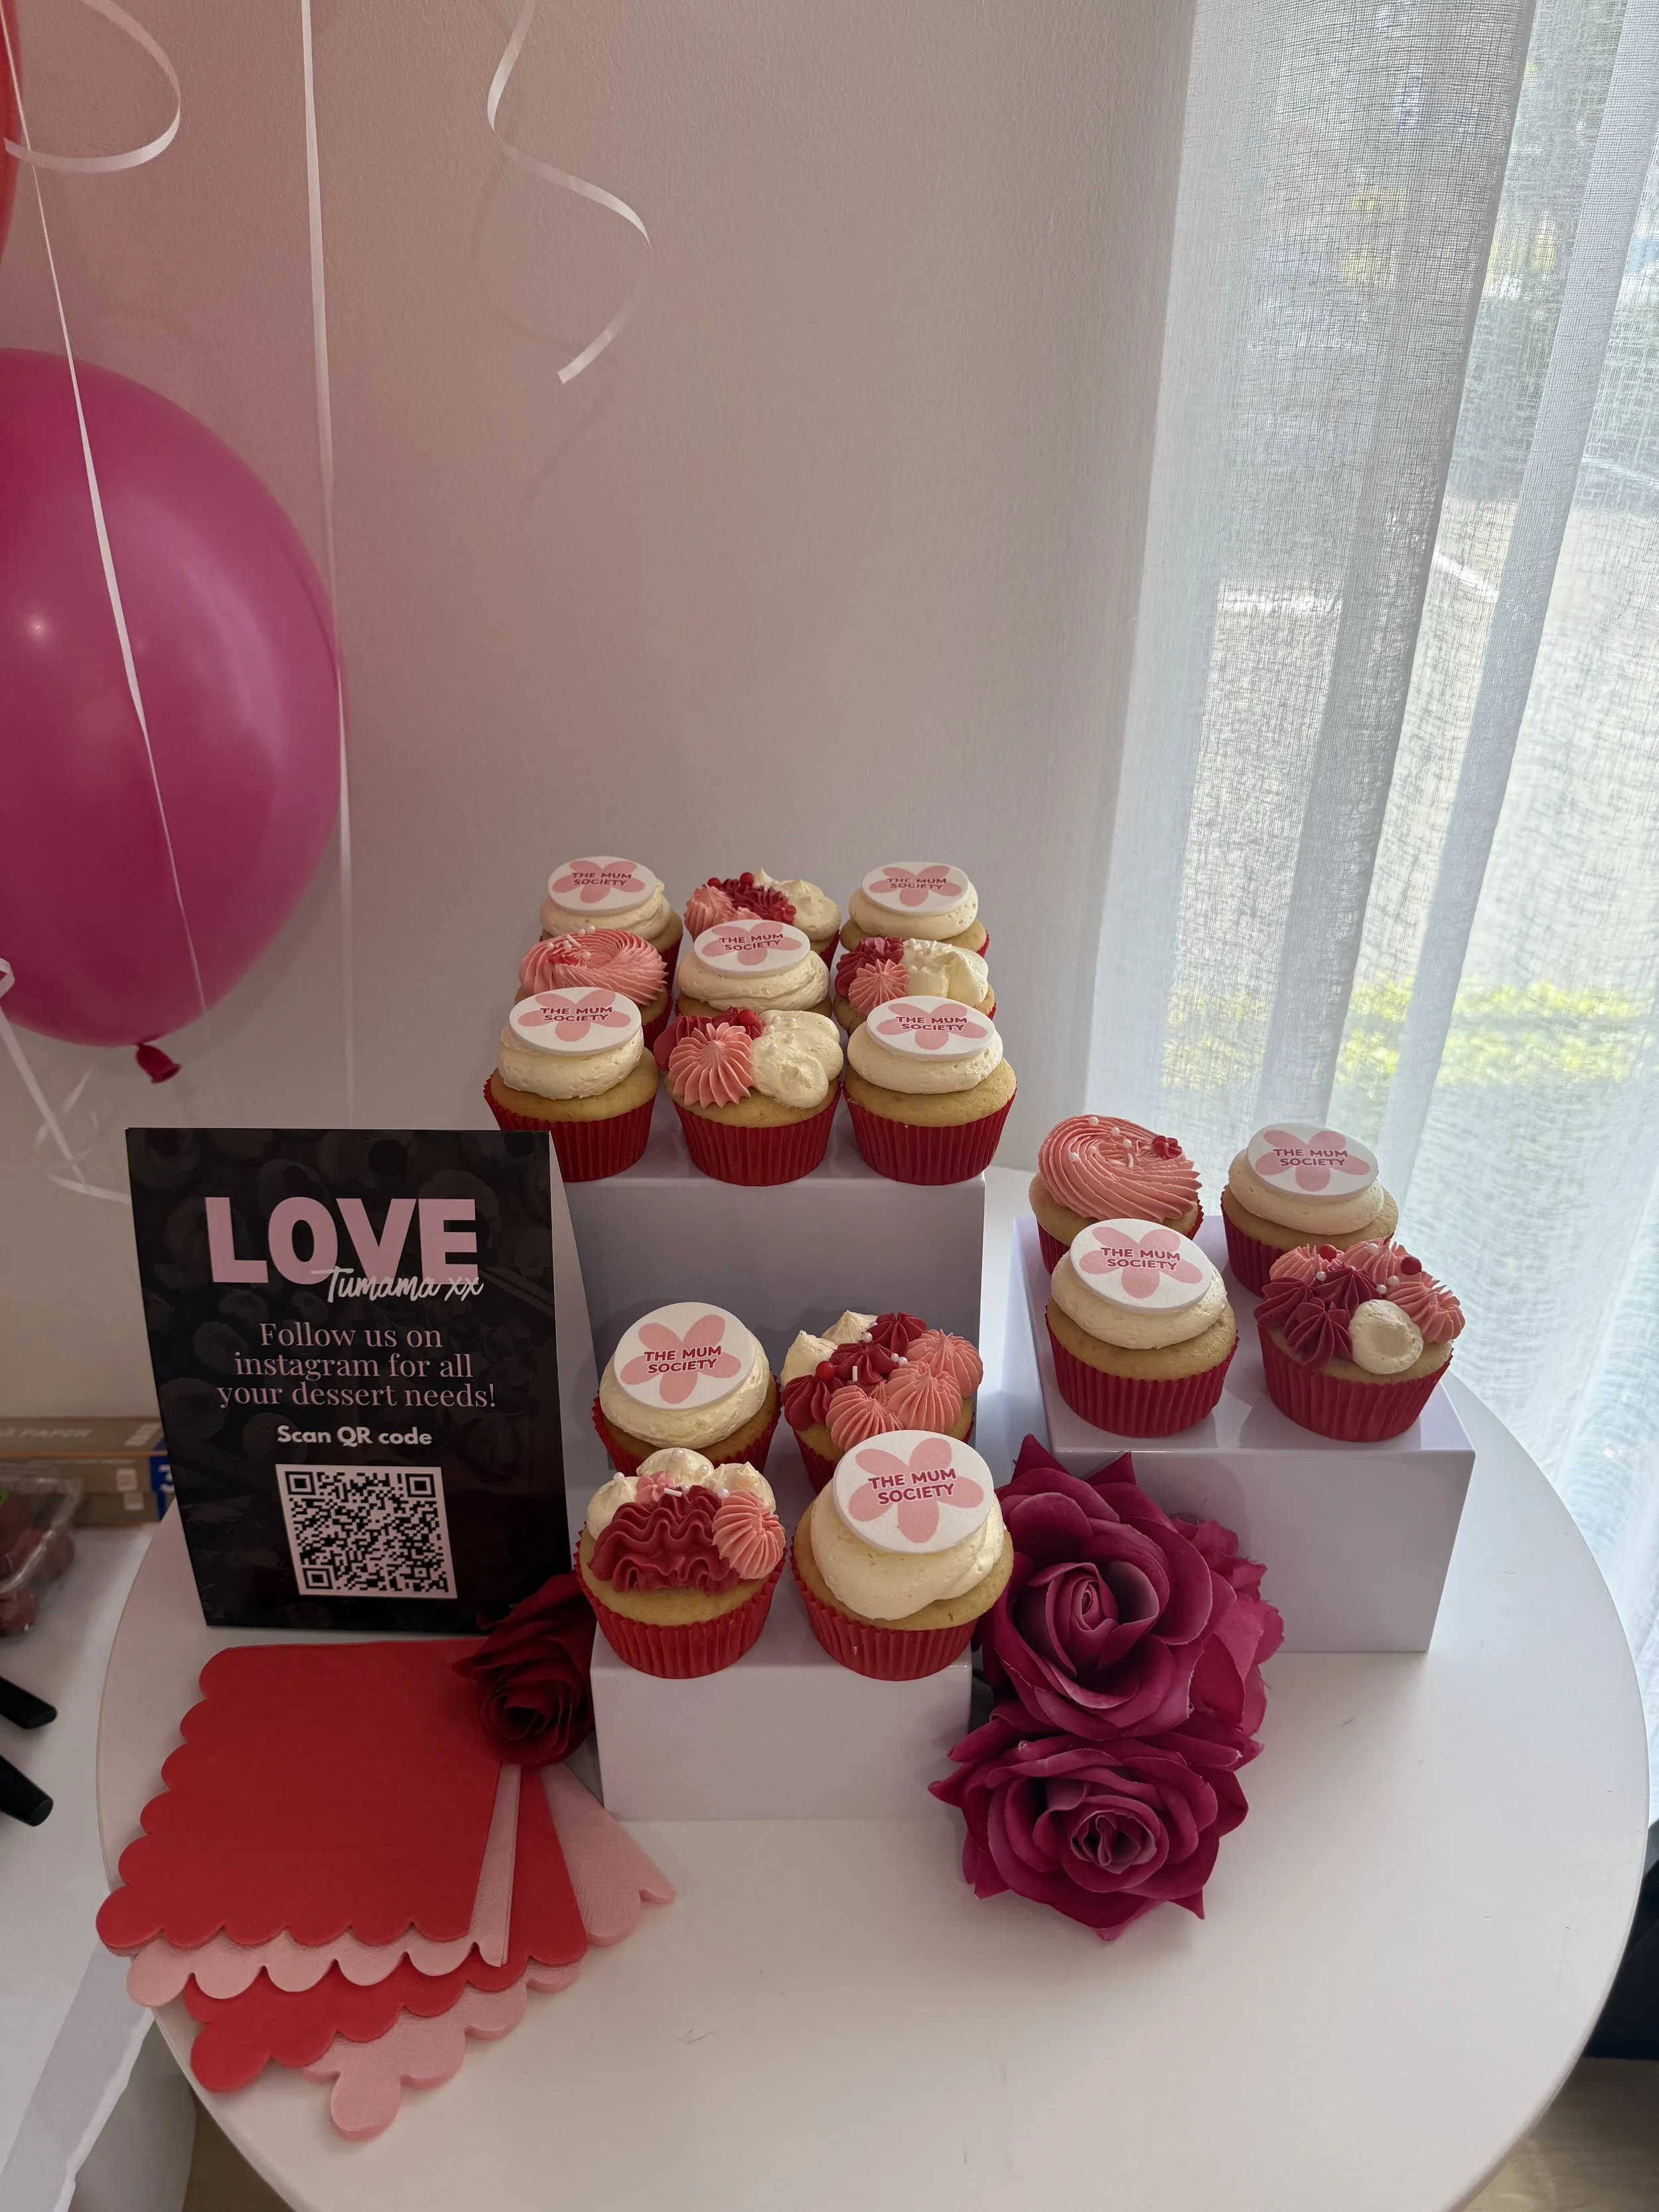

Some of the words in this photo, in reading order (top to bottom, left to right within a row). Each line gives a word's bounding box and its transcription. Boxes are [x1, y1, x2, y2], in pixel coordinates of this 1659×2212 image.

[724, 940, 781, 951] SOCIETY
[205, 1197, 480, 1286] LOVE
[1100, 1248, 1133, 1257] THE
[1140, 1250, 1181, 1260] MUM
[1107, 1259, 1177, 1270] SOCIETY
[311, 1266, 441, 1303] Tumama
[259, 1322, 356, 1348] Follow
[364, 1329, 397, 1349] us
[406, 1329, 444, 1349] on
[644, 1350, 676, 1362] THE
[682, 1346, 721, 1359] MUM
[234, 1351, 379, 1381] instagram
[389, 1353, 430, 1378] for
[439, 1355, 474, 1378] all
[648, 1359, 717, 1374] SOCIETY
[216, 1384, 283, 1408] your
[292, 1382, 398, 1408] dessert
[404, 1383, 496, 1408] needs!
[277, 1425, 332, 1445] Scan
[337, 1426, 373, 1447] QR
[378, 1428, 433, 1445] code
[868, 1475, 904, 1490] THE
[912, 1468, 956, 1484] MUM
[877, 1483, 954, 1505] SOCIETY
